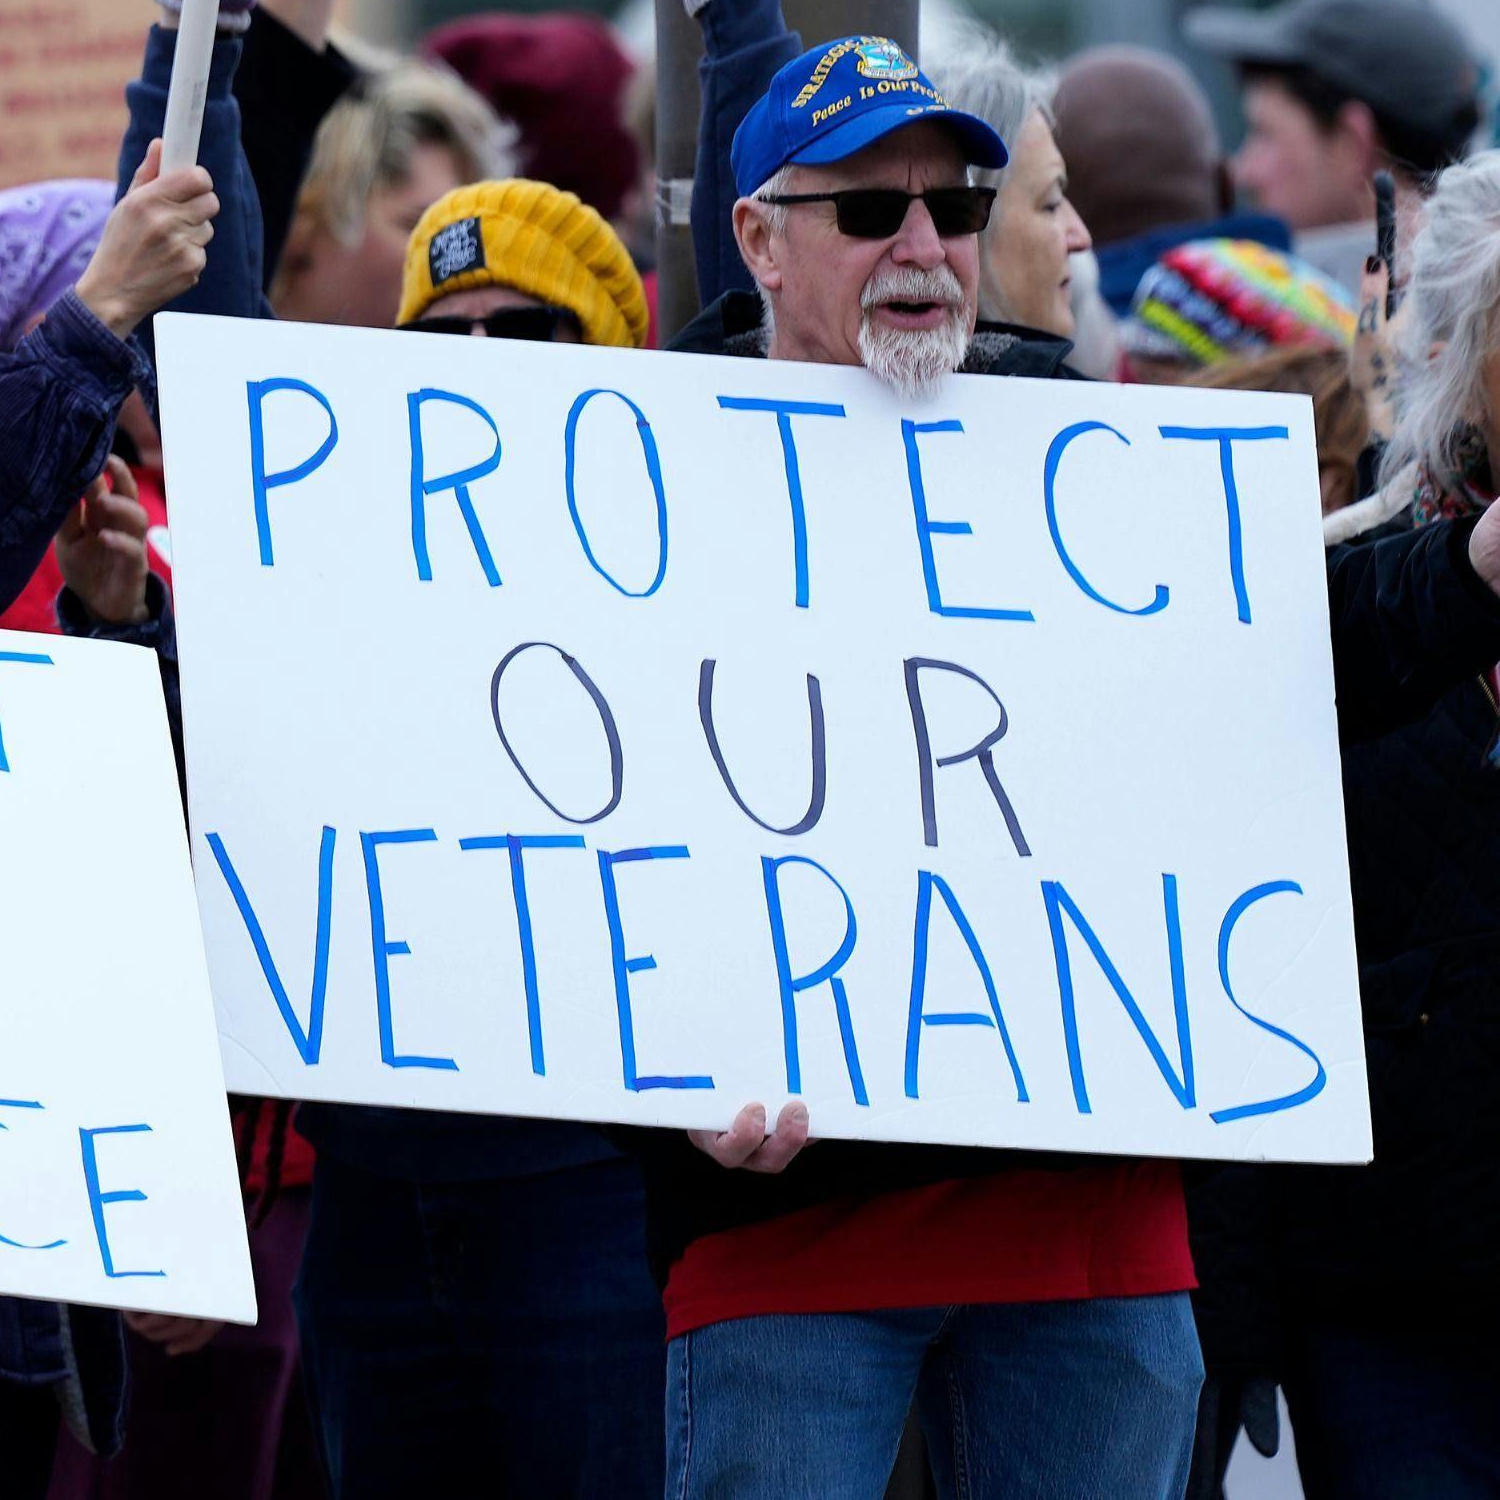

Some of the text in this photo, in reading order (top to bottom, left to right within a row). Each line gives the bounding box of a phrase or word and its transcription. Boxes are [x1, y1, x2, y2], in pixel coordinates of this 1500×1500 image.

[812, 95, 852, 127] Peace
[859, 87, 875, 100] Is
[877, 80, 909, 95] Our
[246, 378, 1290, 624] PROTECT
[491, 643, 1031, 856] OUR
[205, 826, 1327, 1124] VETERANS
